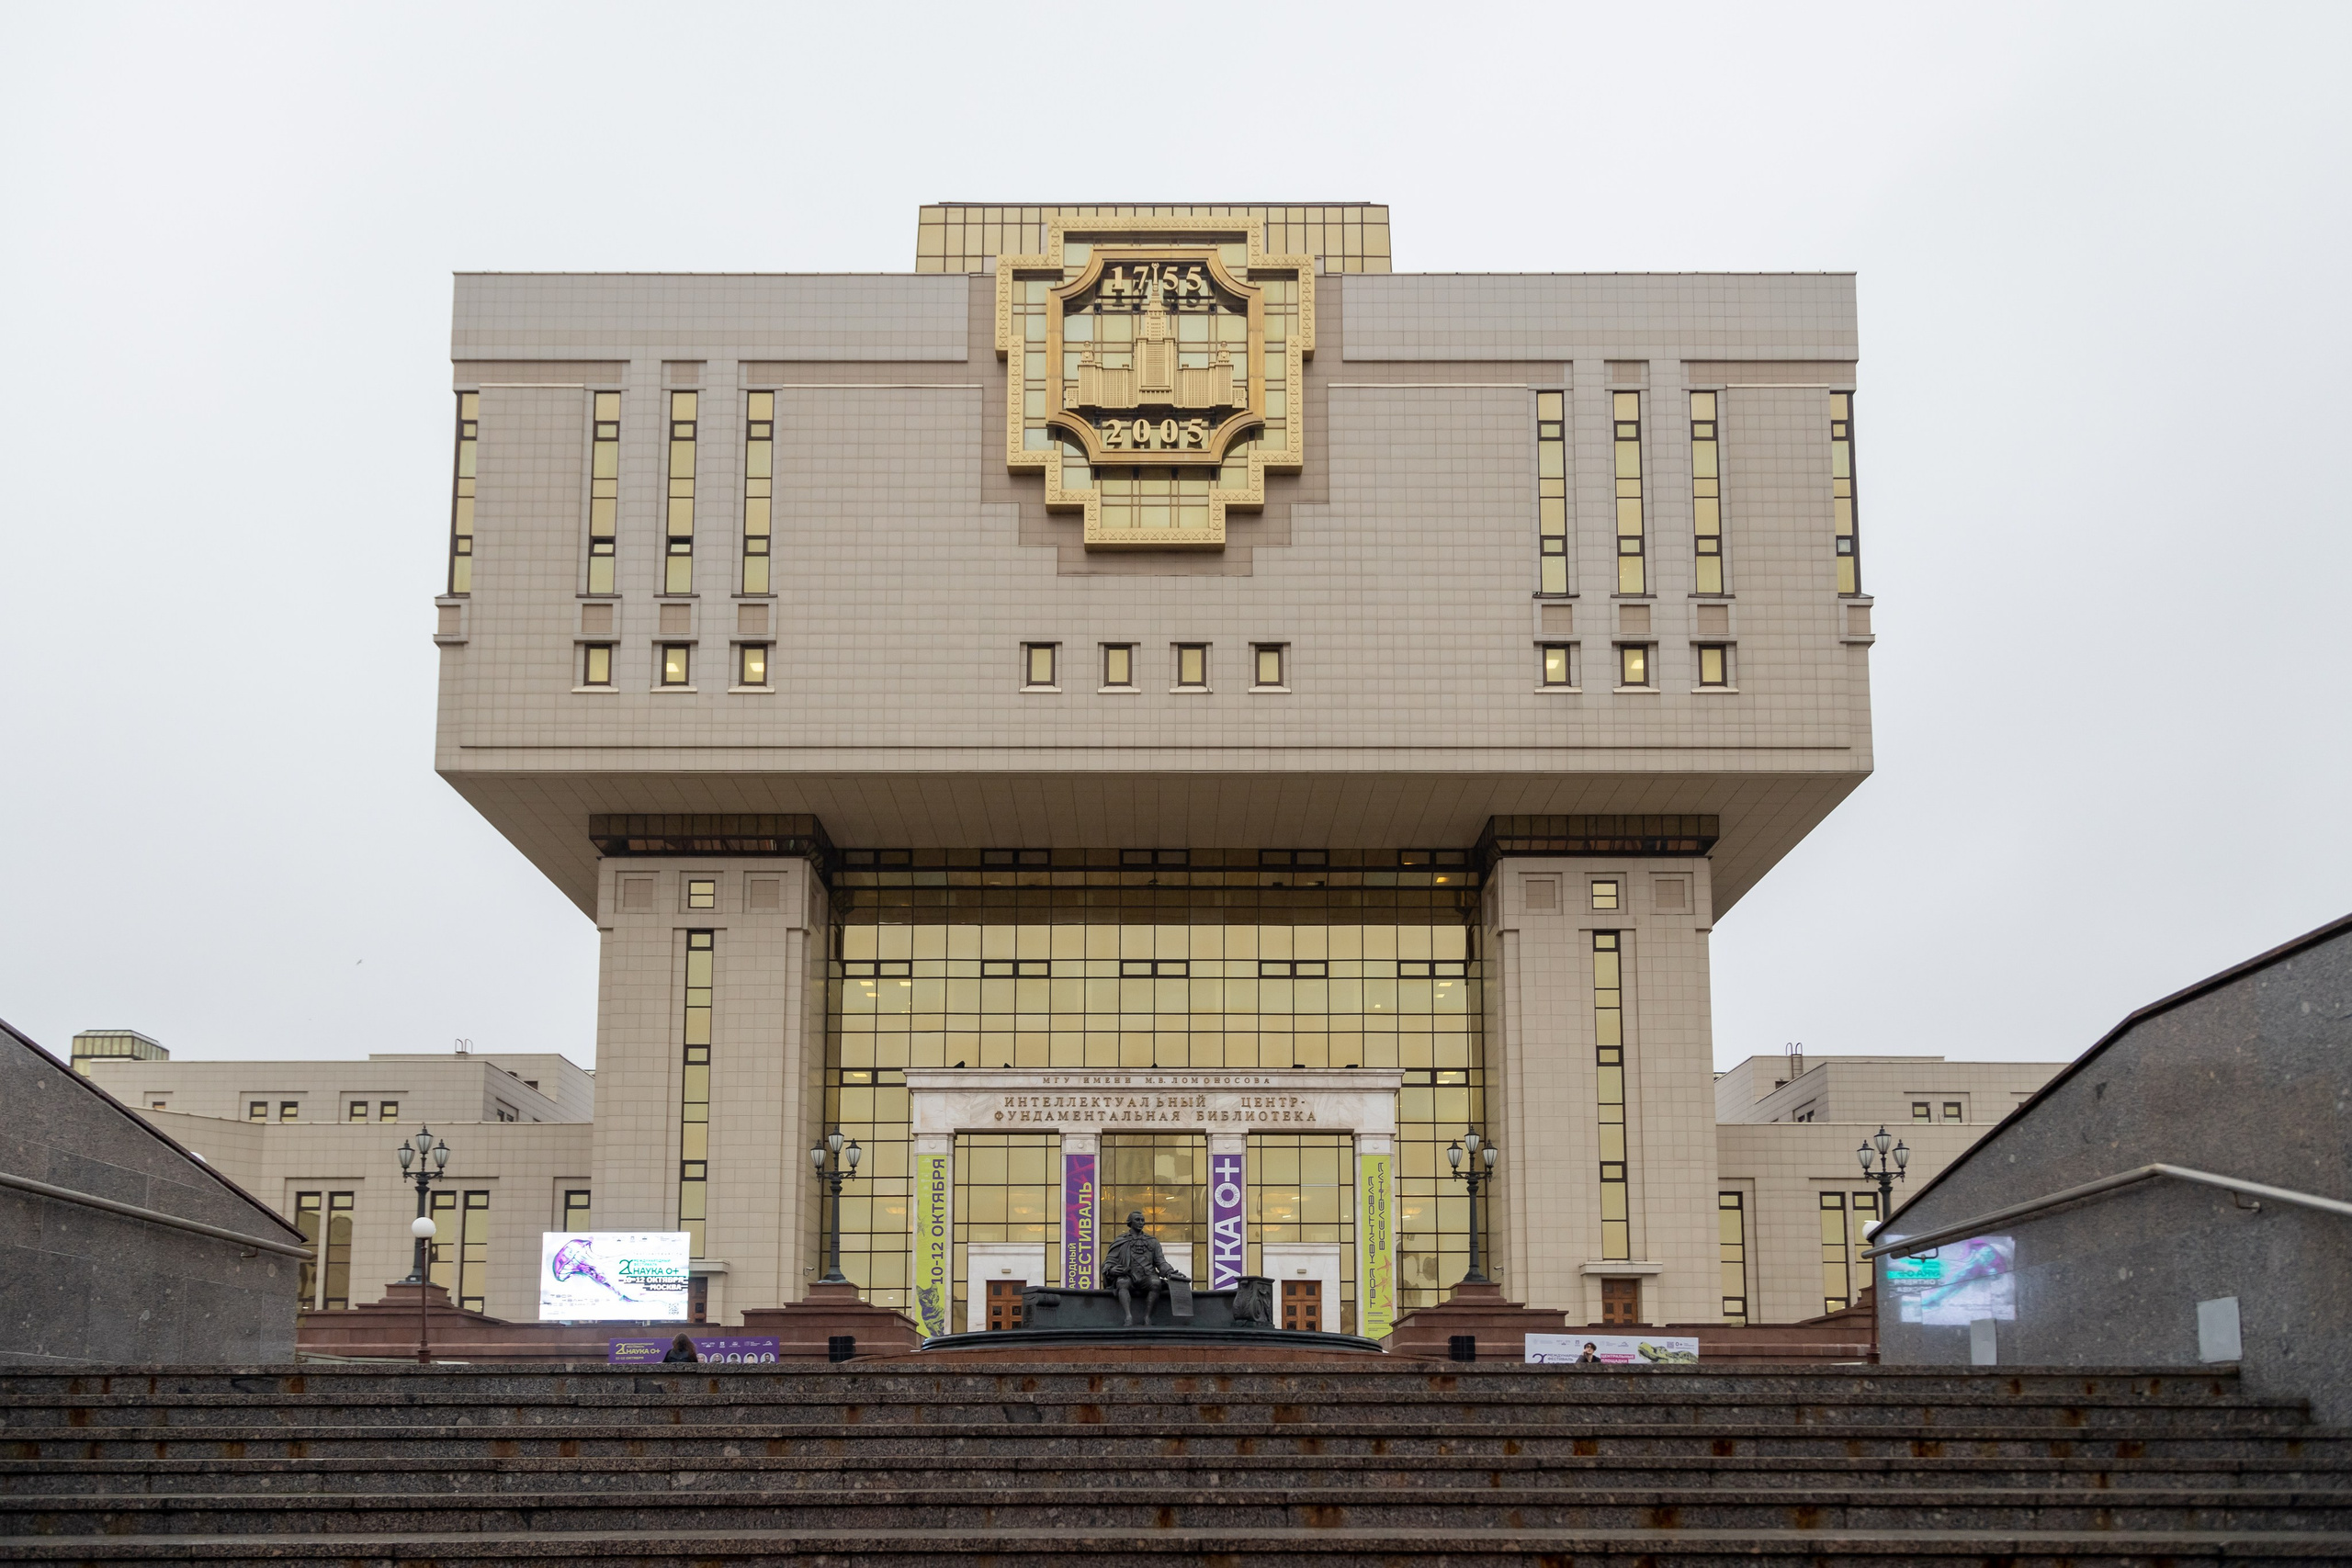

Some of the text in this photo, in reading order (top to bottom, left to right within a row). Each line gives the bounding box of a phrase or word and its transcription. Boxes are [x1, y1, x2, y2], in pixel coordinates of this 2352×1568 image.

[1111, 265, 1203, 292] 1755
[1106, 418, 1204, 444] 2005
[1043, 1077, 1070, 1085] МГУ
[1083, 1077, 1132, 1085] ИМЕНИ
[1170, 1077, 1271, 1085] ЛОМОНОСОВА
[1004, 1094, 1206, 1108] ИНТЕЛЛЕКТУАЛЬНЫЙ
[993, 1111, 1317, 1122] ФУНДАМЕНТАЛЬНАЯ БИБЛИОТЕКА
[931, 1158, 945, 1285] 10-12 ОКТЯБРЯ
[1078, 1181, 1092, 1290] ФЕСТИВАЛЬ
